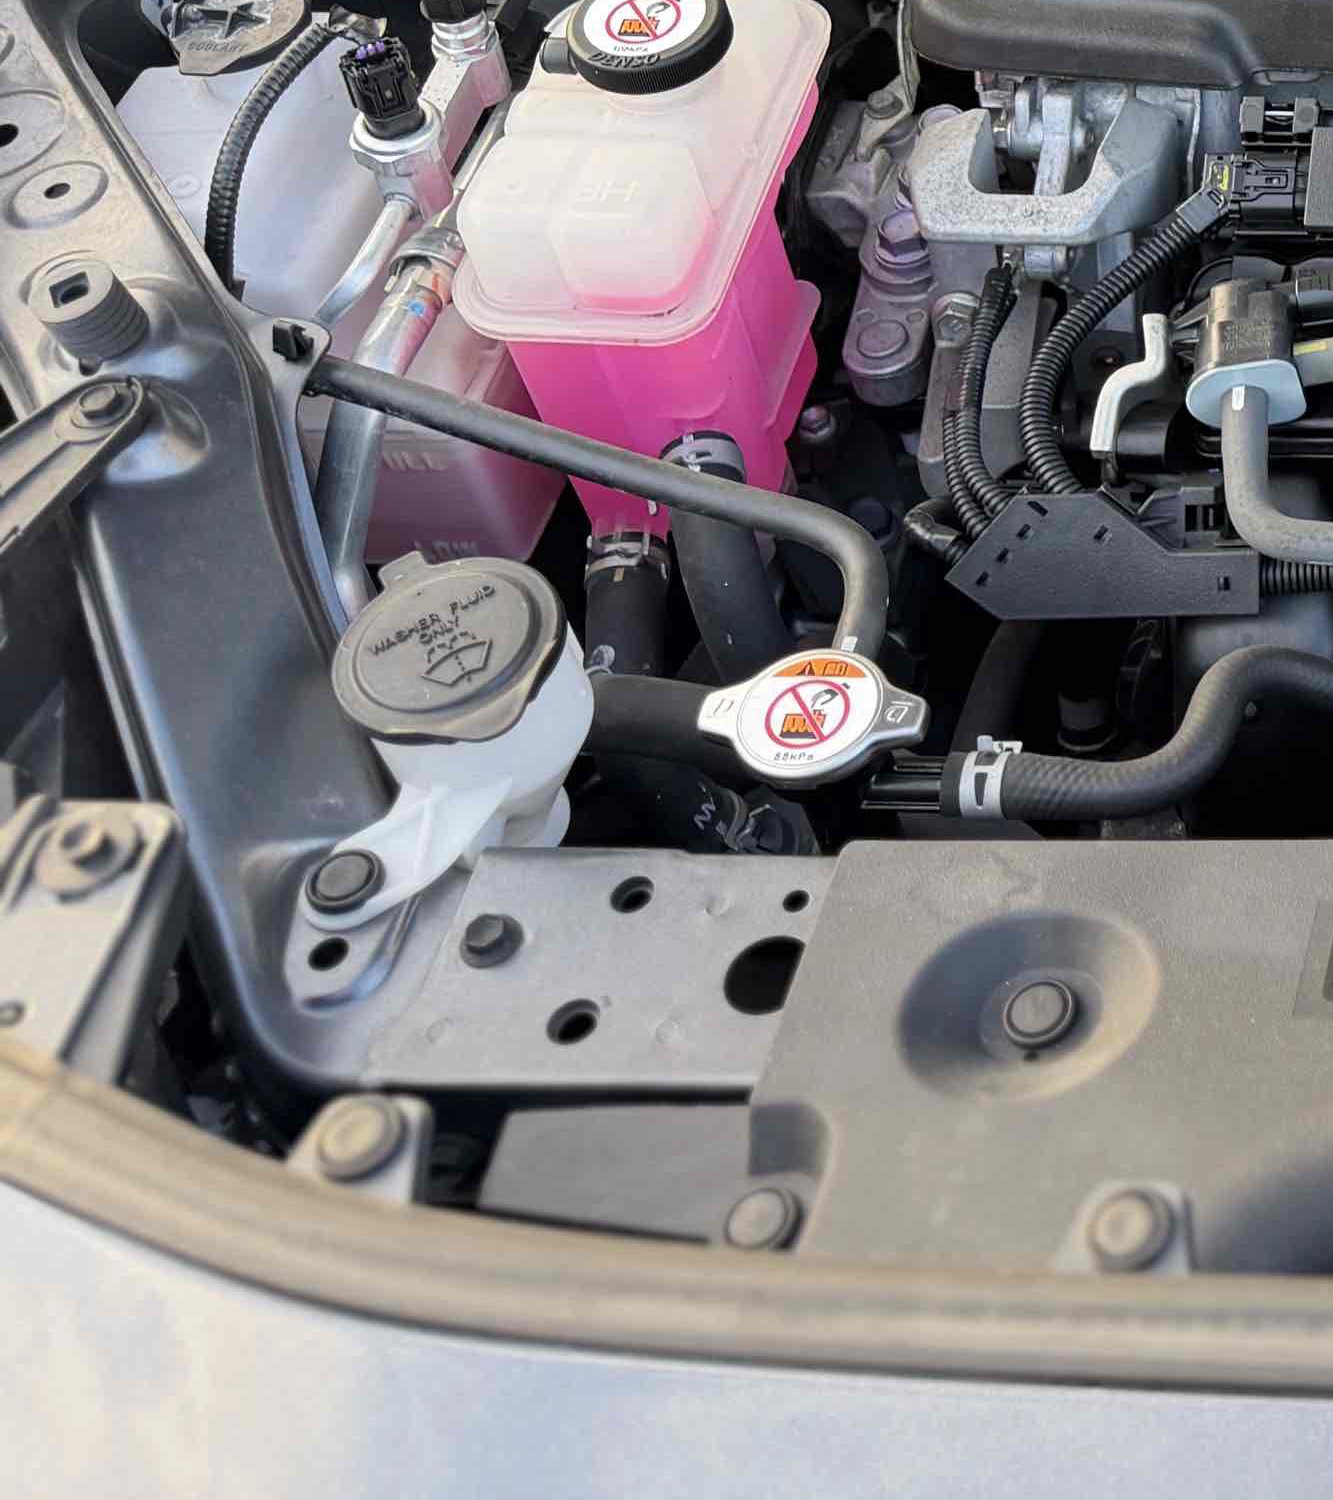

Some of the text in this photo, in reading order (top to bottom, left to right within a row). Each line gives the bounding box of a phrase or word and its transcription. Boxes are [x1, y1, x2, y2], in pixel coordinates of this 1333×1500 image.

[590, 52, 663, 70] DENSO
[368, 582, 496, 657] WASHER FLUID
[419, 614, 459, 645] ONLY
